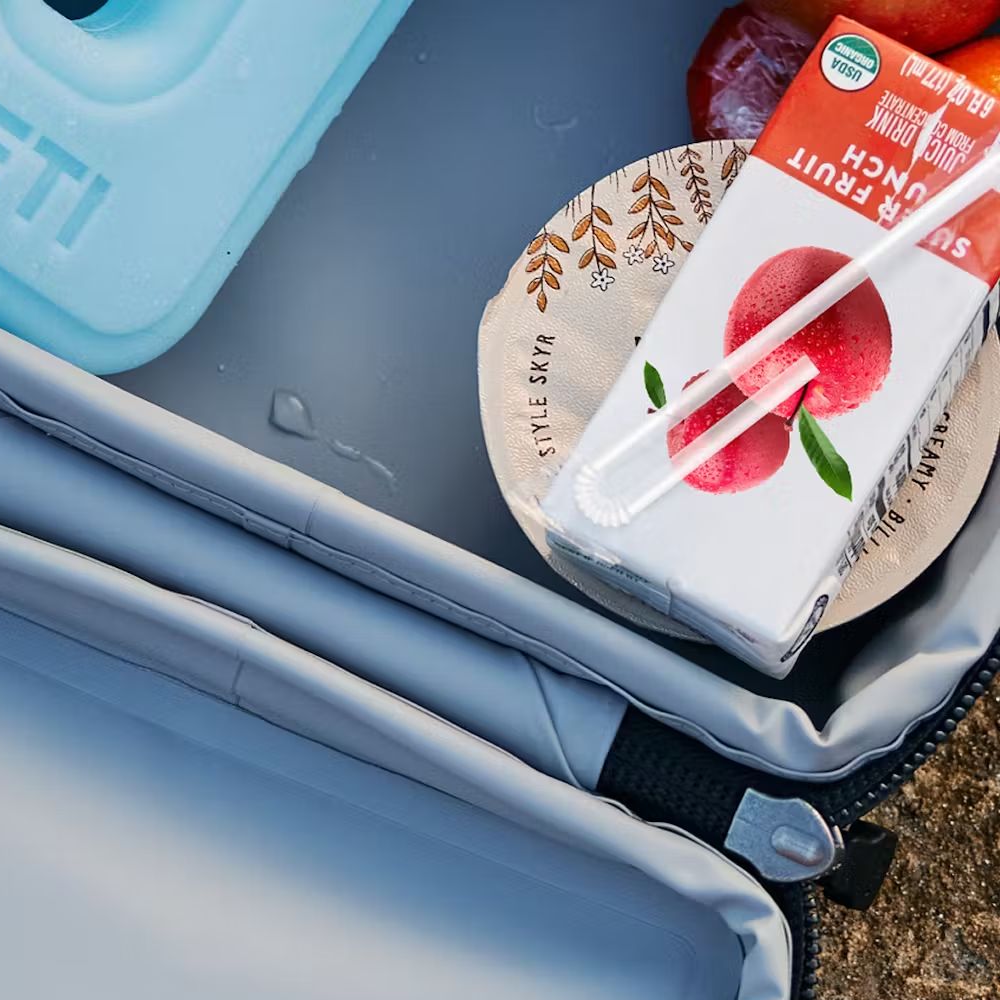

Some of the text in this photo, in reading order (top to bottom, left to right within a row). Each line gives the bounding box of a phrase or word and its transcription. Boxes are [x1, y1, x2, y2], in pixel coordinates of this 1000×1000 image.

[830, 57, 863, 82] USDA
[834, 42, 874, 69] ORGANIC
[967, 87, 984, 113] FL
[979, 96, 996, 119] 6
[865, 105, 918, 147] DRINK
[879, 90, 975, 154] FROM COCENTRATE
[786, 147, 874, 205] FRUIT
[841, 144, 928, 201] UNCH
[529, 334, 556, 457] STYLE SKYR
